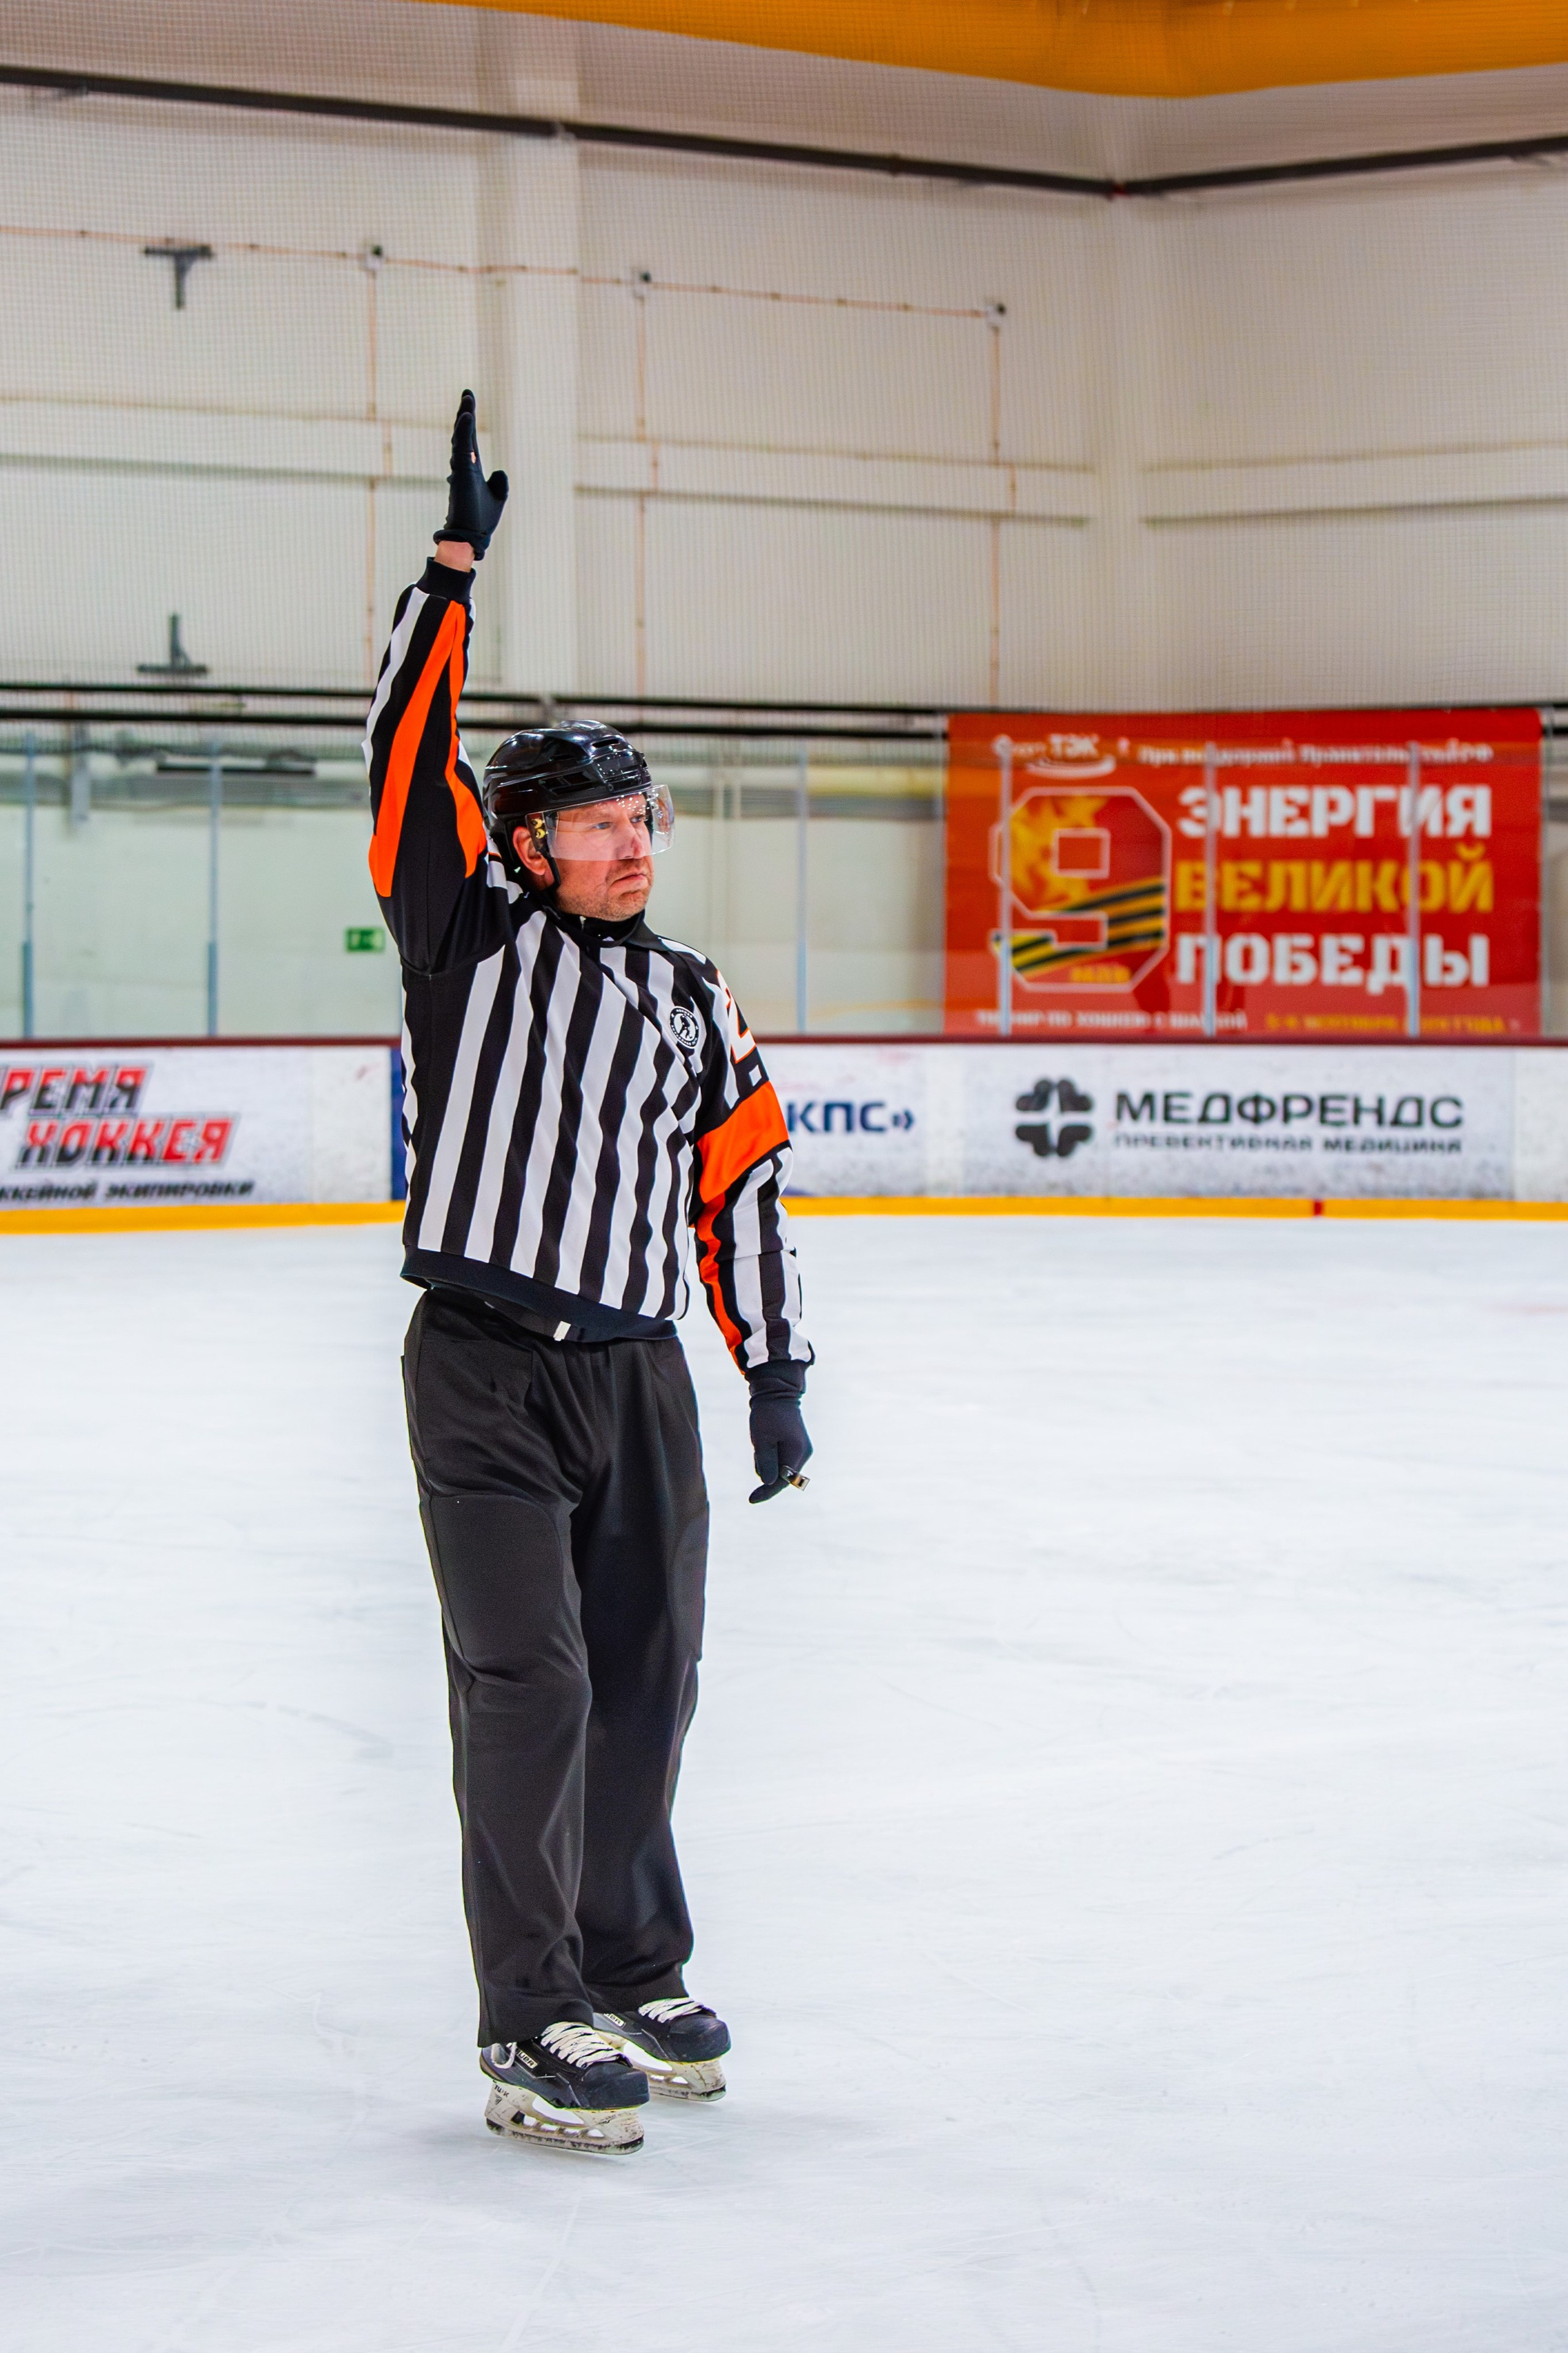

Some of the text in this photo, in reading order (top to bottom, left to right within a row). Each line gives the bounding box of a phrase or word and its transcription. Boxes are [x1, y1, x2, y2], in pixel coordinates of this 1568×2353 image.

[1177, 785, 1491, 837] ЭНЕРГИЯ
[1175, 842, 1493, 912] ВЕЛИКОЙ
[1177, 933, 1489, 994] ПОБЕДЫ
[1115, 1092, 1464, 1128] МЕДФРЕНДС
[21, 1119, 234, 1164] ХОККЕЯ
[1115, 1135, 1462, 1153] ПРЕВЕНТИВНАЯ МЕДИЦИНА
